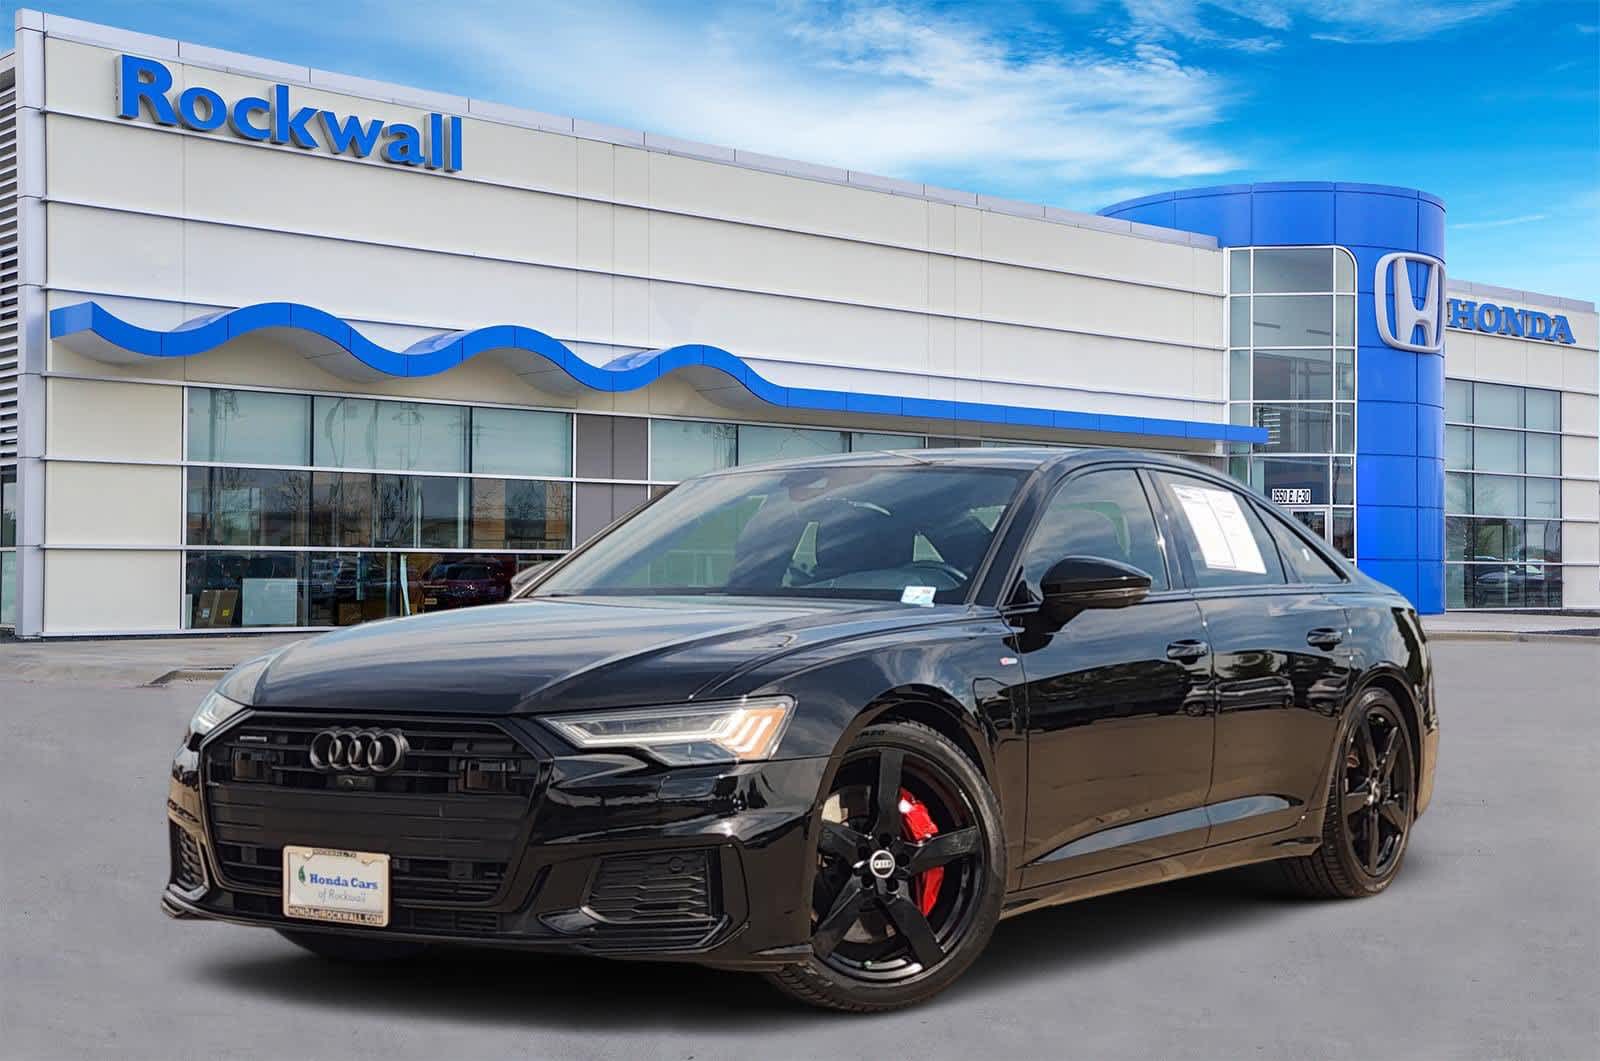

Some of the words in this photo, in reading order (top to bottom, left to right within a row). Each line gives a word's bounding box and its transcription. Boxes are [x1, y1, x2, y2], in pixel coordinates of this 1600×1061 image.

[116, 54, 463, 172] Rockwall
[1447, 298, 1577, 345] HONDA
[309, 873, 349, 887] Honda
[350, 878, 378, 890] Cars
[318, 888, 327, 904] of
